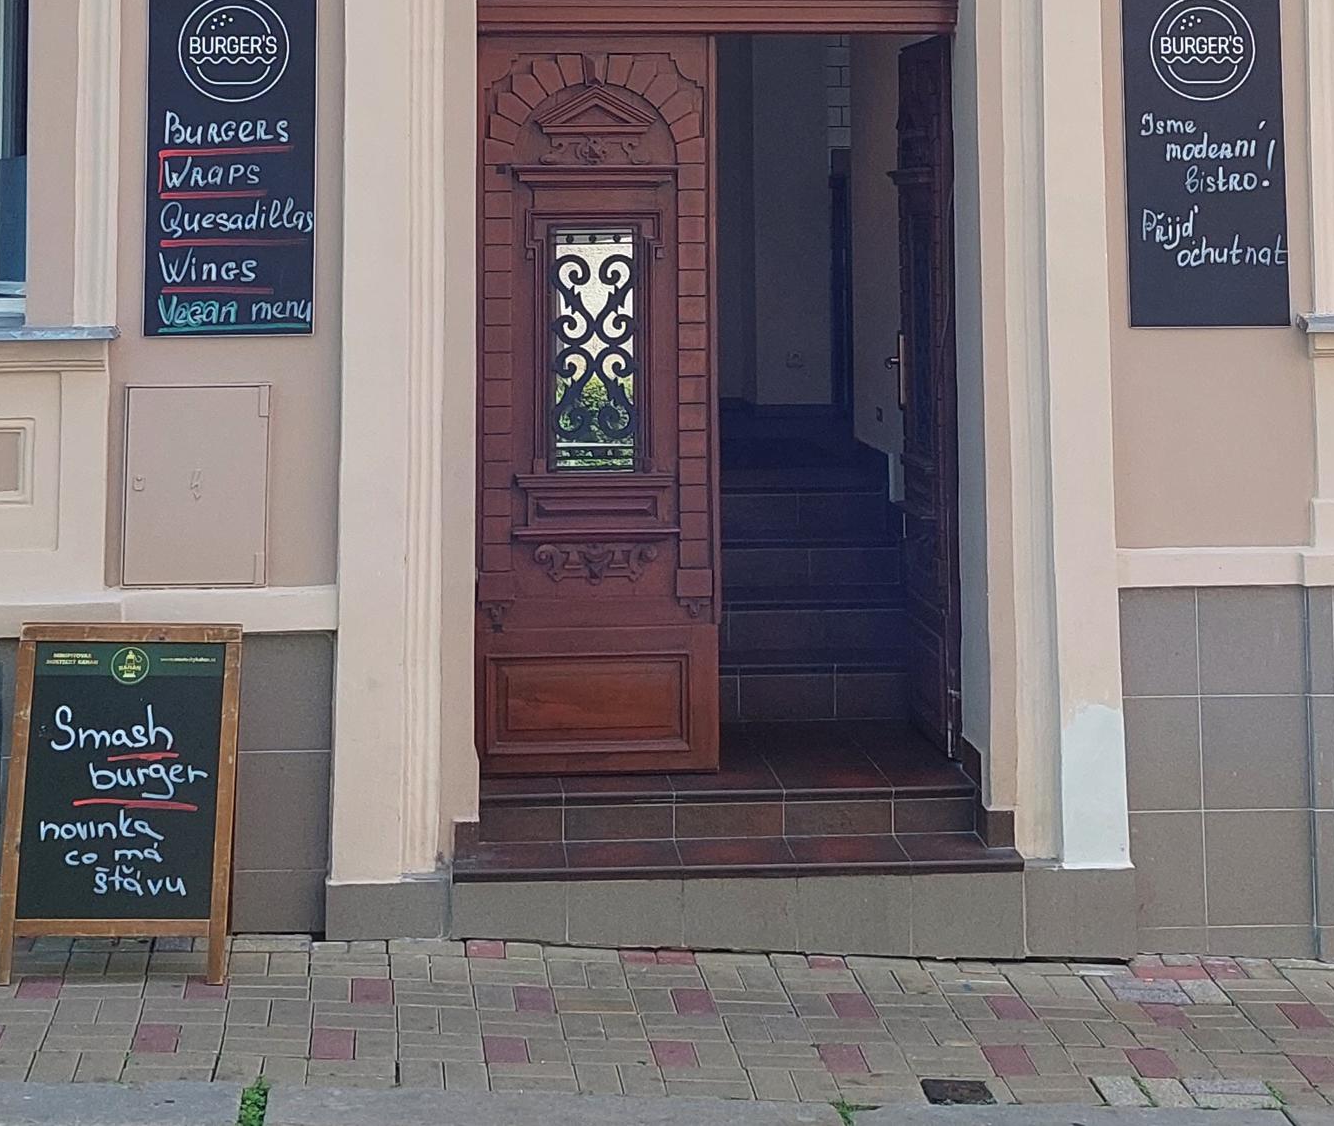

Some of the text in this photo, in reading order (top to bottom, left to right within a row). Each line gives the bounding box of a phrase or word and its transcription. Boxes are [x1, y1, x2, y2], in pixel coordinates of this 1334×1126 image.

[189, 34, 278, 55] BURGER'S
[1160, 35, 1244, 55] BURGER'S
[160, 197, 314, 238] Quesadillas
[251, 299, 312, 322] menu
[50, 704, 174, 752] Smash
[89, 762, 209, 799] burger
[40, 809, 165, 842] novinka
[64, 842, 164, 866] co má
